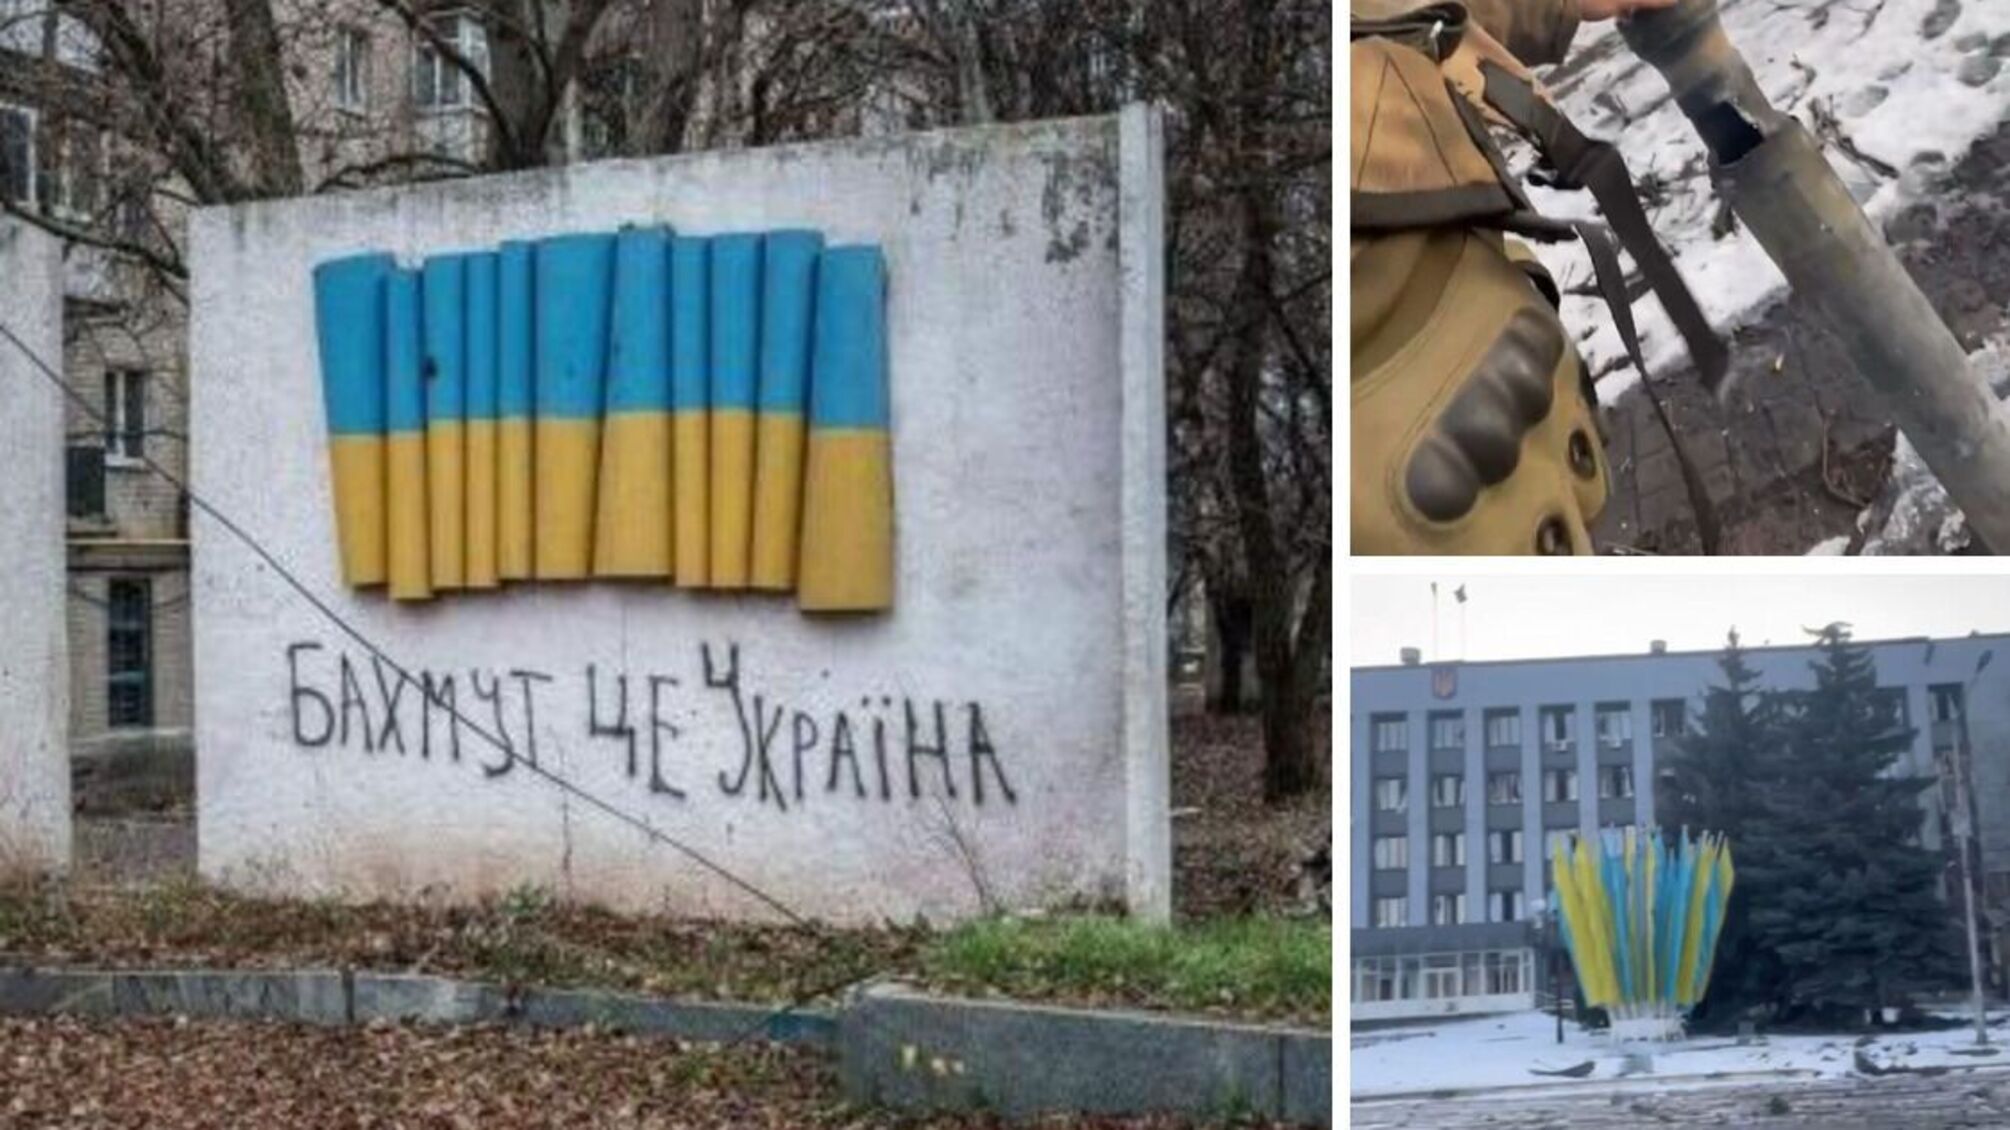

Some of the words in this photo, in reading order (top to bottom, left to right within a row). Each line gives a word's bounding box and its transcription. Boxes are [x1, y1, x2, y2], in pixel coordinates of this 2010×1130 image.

[286, 642, 552, 778] БАХМУТ
[586, 663, 685, 799] ЦЕ
[701, 641, 1017, 811] УКРАЇНА
